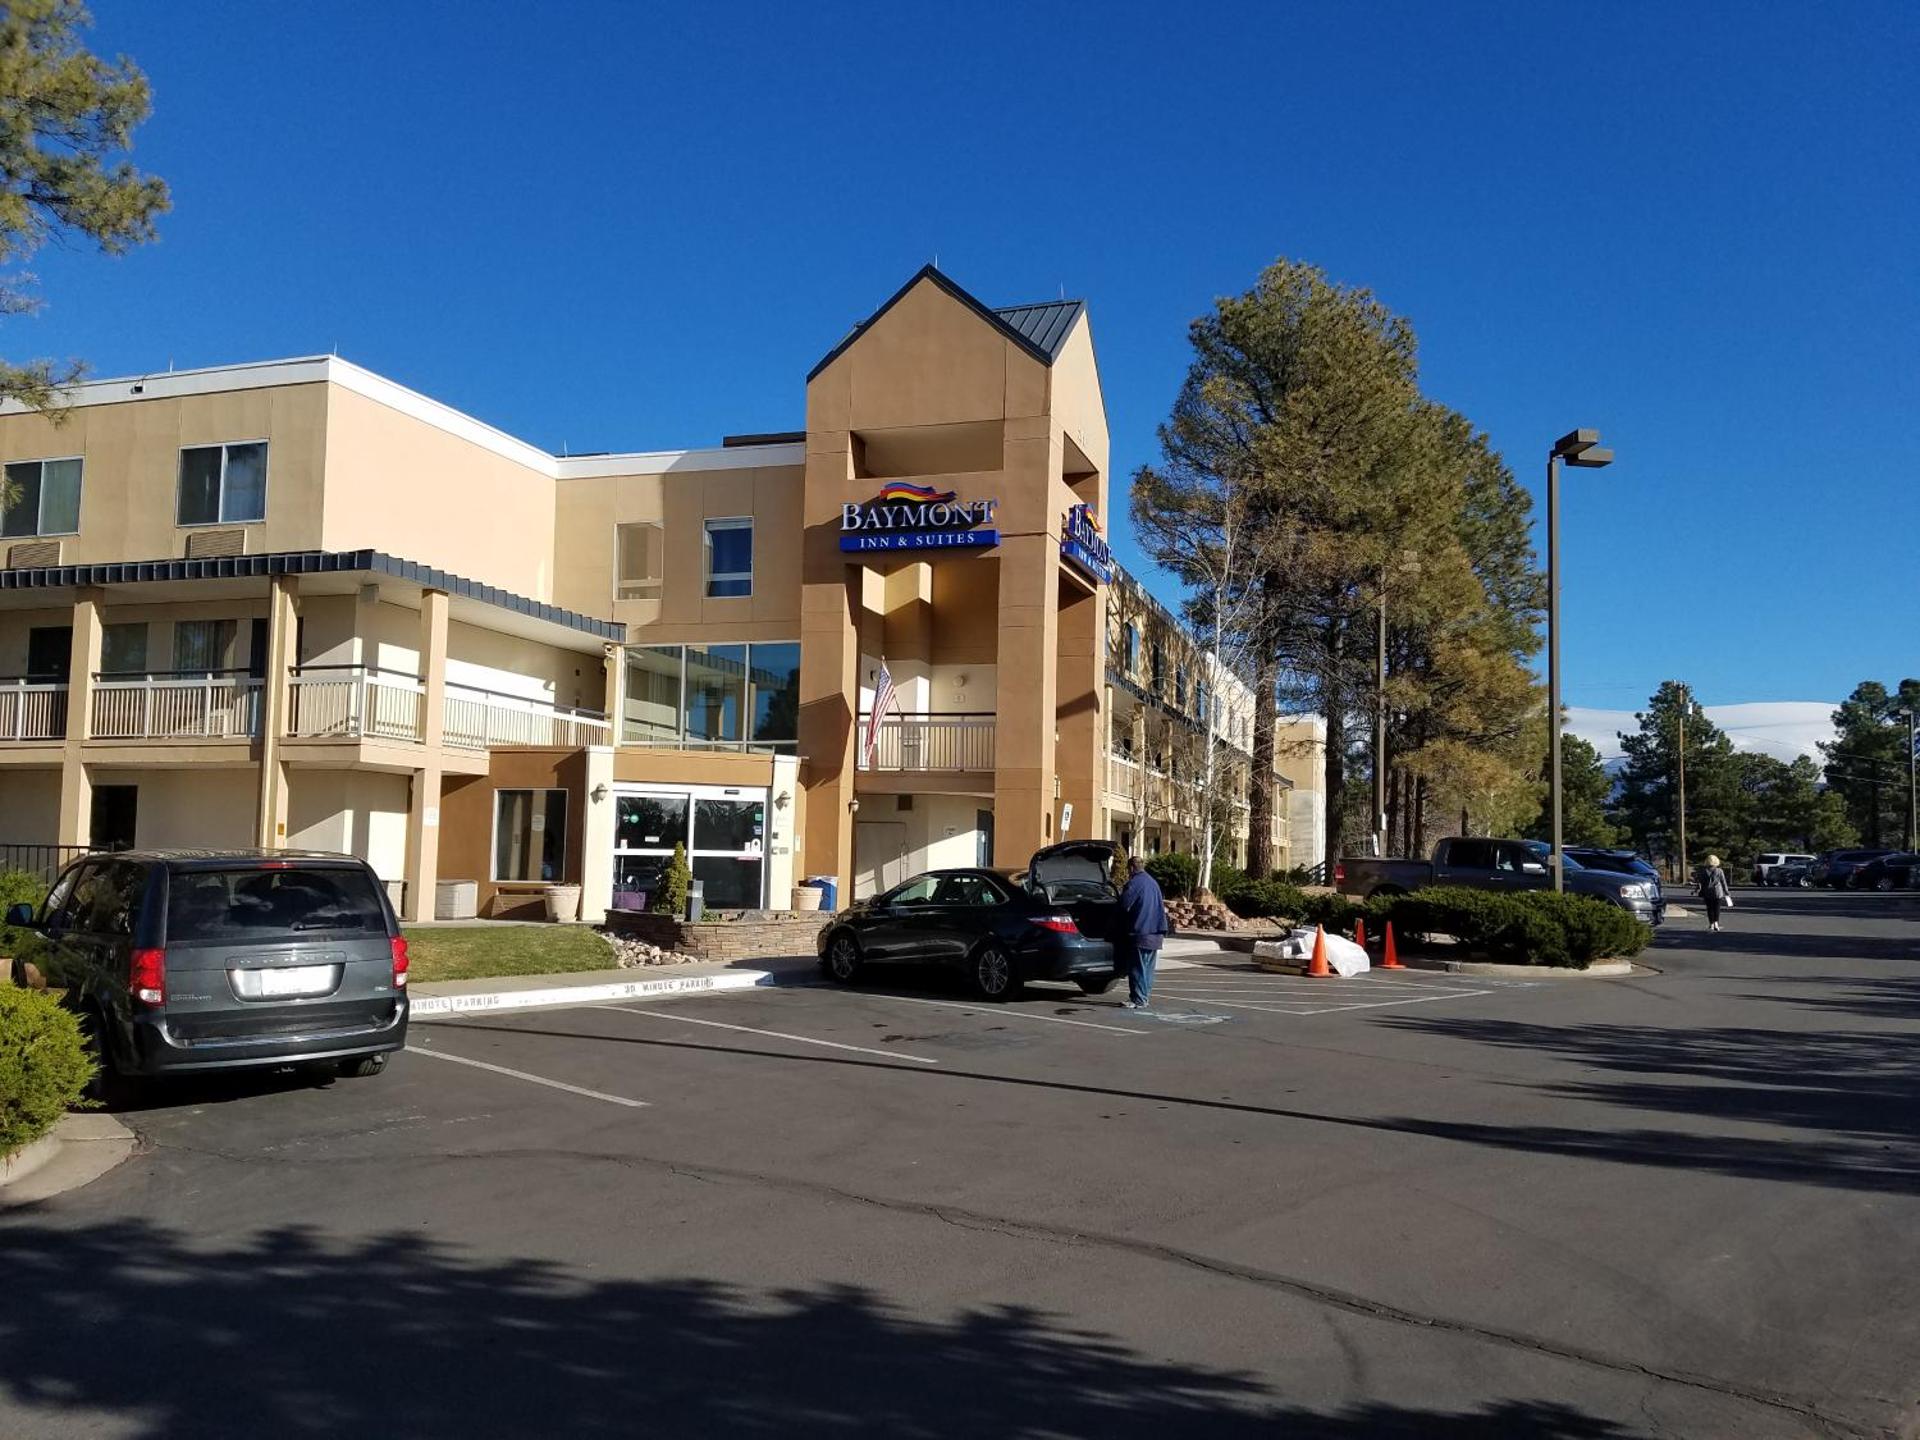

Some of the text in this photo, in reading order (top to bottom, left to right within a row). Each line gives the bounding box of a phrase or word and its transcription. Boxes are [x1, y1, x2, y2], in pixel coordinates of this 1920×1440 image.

[840, 501, 993, 531] BAYMONT
[860, 533, 975, 548] INN & SUITES
[456, 995, 500, 1008] PARKING
